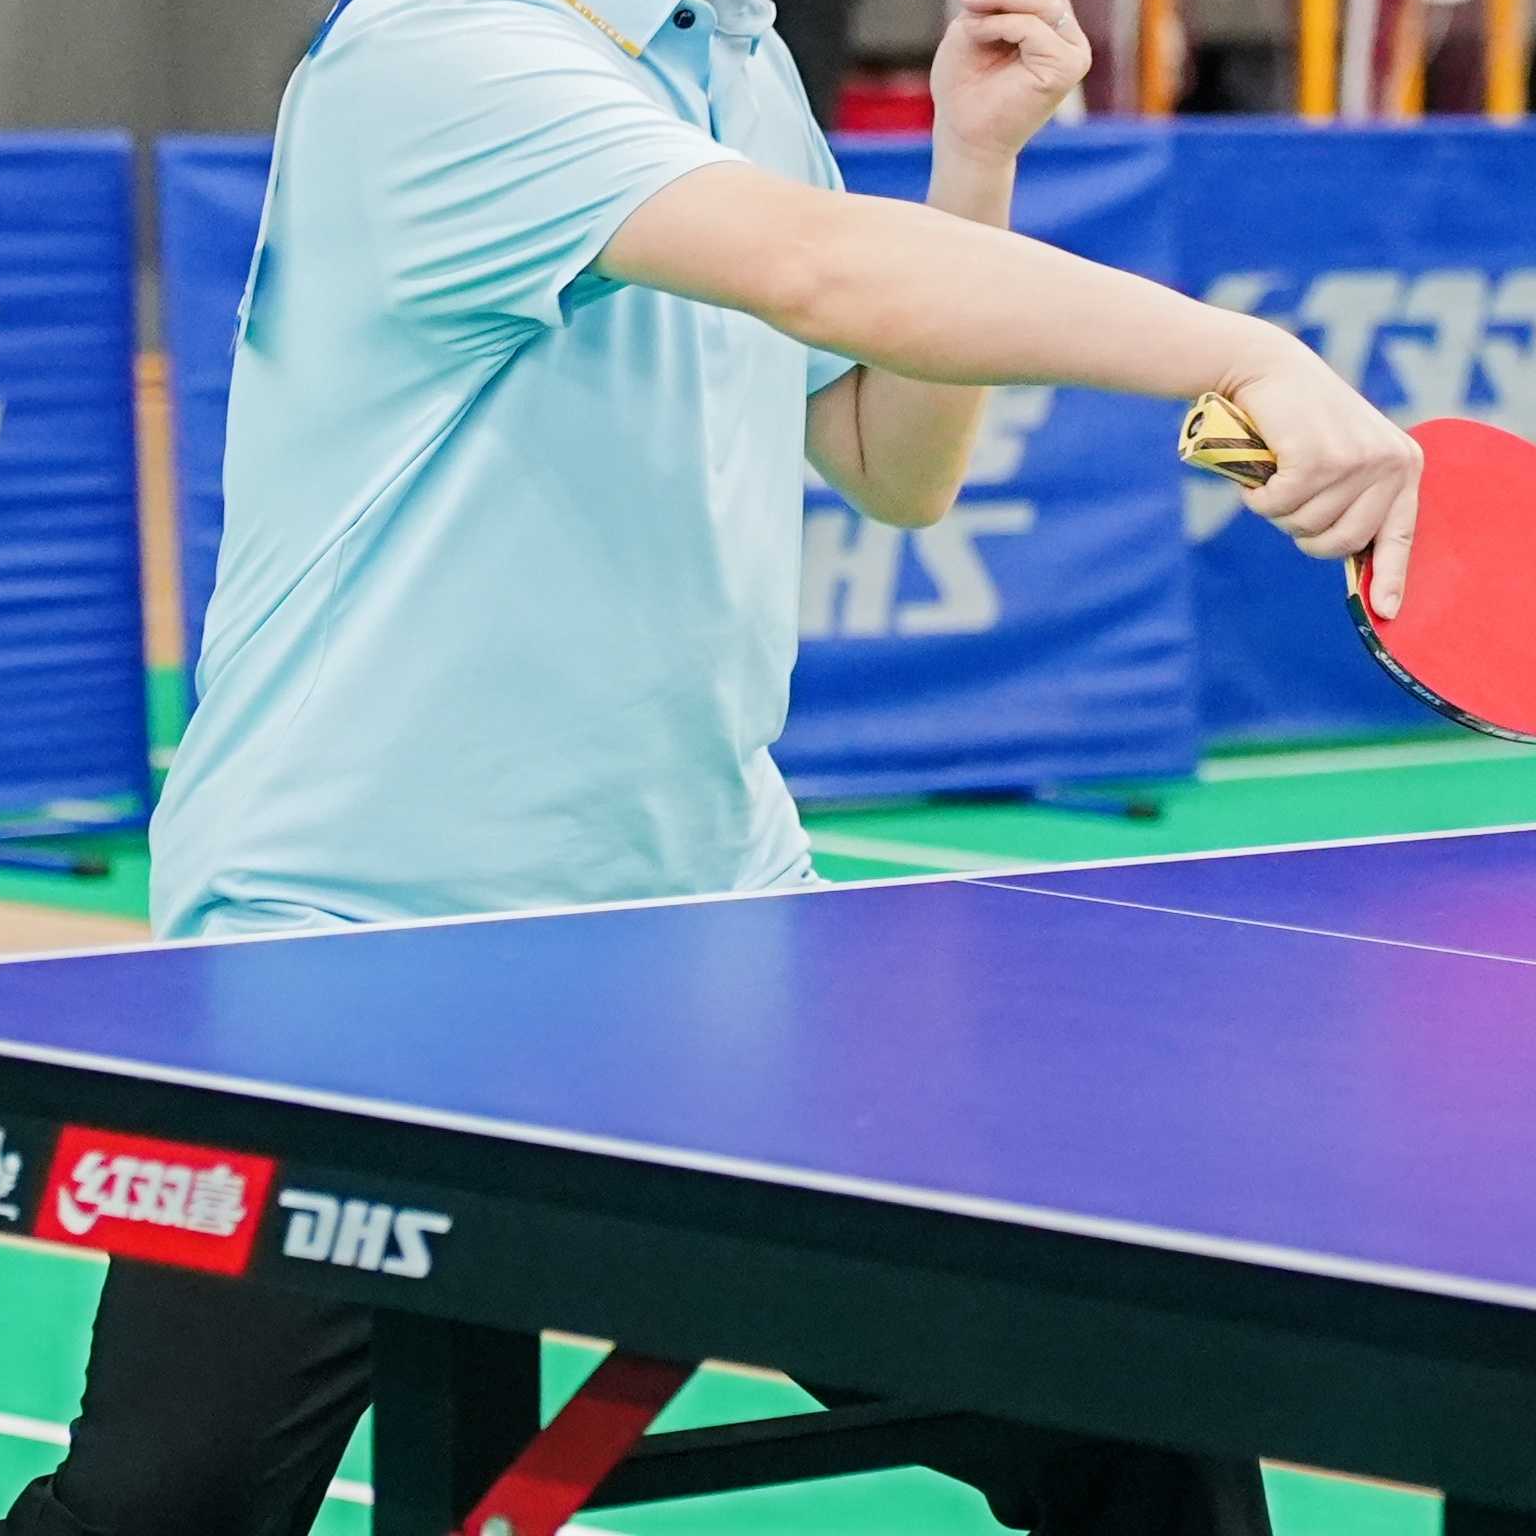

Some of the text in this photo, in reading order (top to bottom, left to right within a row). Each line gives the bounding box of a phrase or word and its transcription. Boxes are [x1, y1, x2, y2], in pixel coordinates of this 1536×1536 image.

[798, 498, 1036, 638] HS
[57, 1150, 248, 1238] 红双喜
[277, 1187, 454, 1280] DHS
